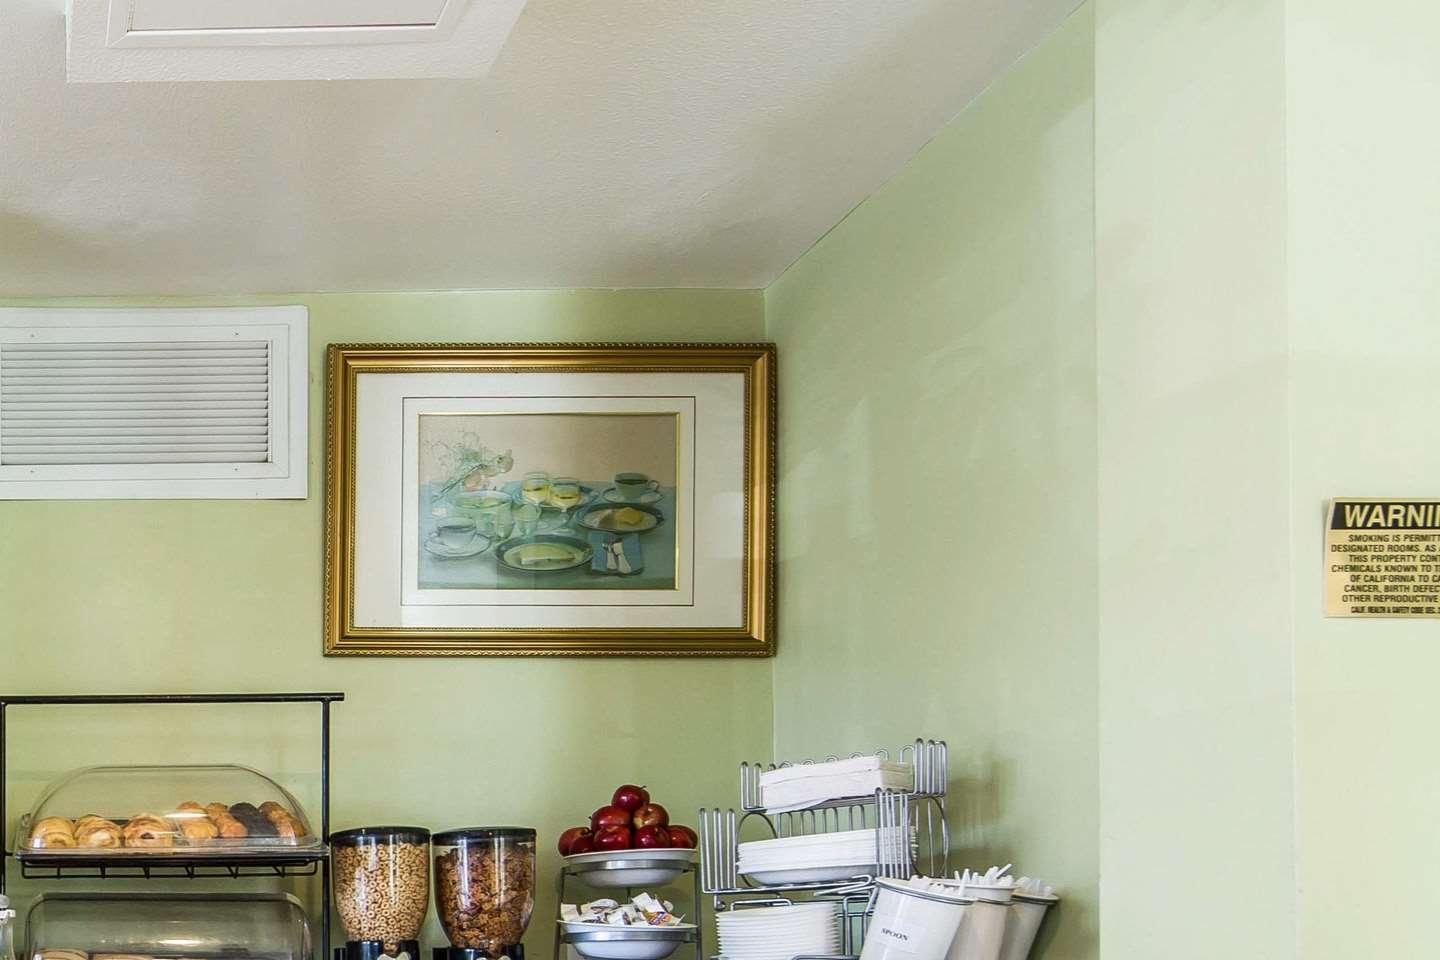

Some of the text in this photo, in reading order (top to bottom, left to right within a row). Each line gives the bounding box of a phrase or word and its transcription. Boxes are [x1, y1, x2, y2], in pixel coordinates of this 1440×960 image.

[1348, 534, 1389, 542] SMOKING
[1392, 534, 1400, 542] IS
[1331, 544, 1385, 552] DESIGNATED
[1424, 544, 1436, 552] AS
[1349, 554, 1368, 562] THIS
[1371, 554, 1417, 562] PROPERTY
[1331, 564, 1381, 573] CHEMICALS
[1384, 564, 1417, 573] KNOWN
[1421, 564, 1432, 573] TO
[1350, 574, 1361, 583] OF
[1363, 574, 1415, 583] CALIFORNIA
[1418, 574, 1429, 583] TO
[1384, 584, 1410, 593] BIRTH
[1342, 594, 1438, 603] OTHER REPRODUCTIVE
[881, 927, 908, 941] SPOON
